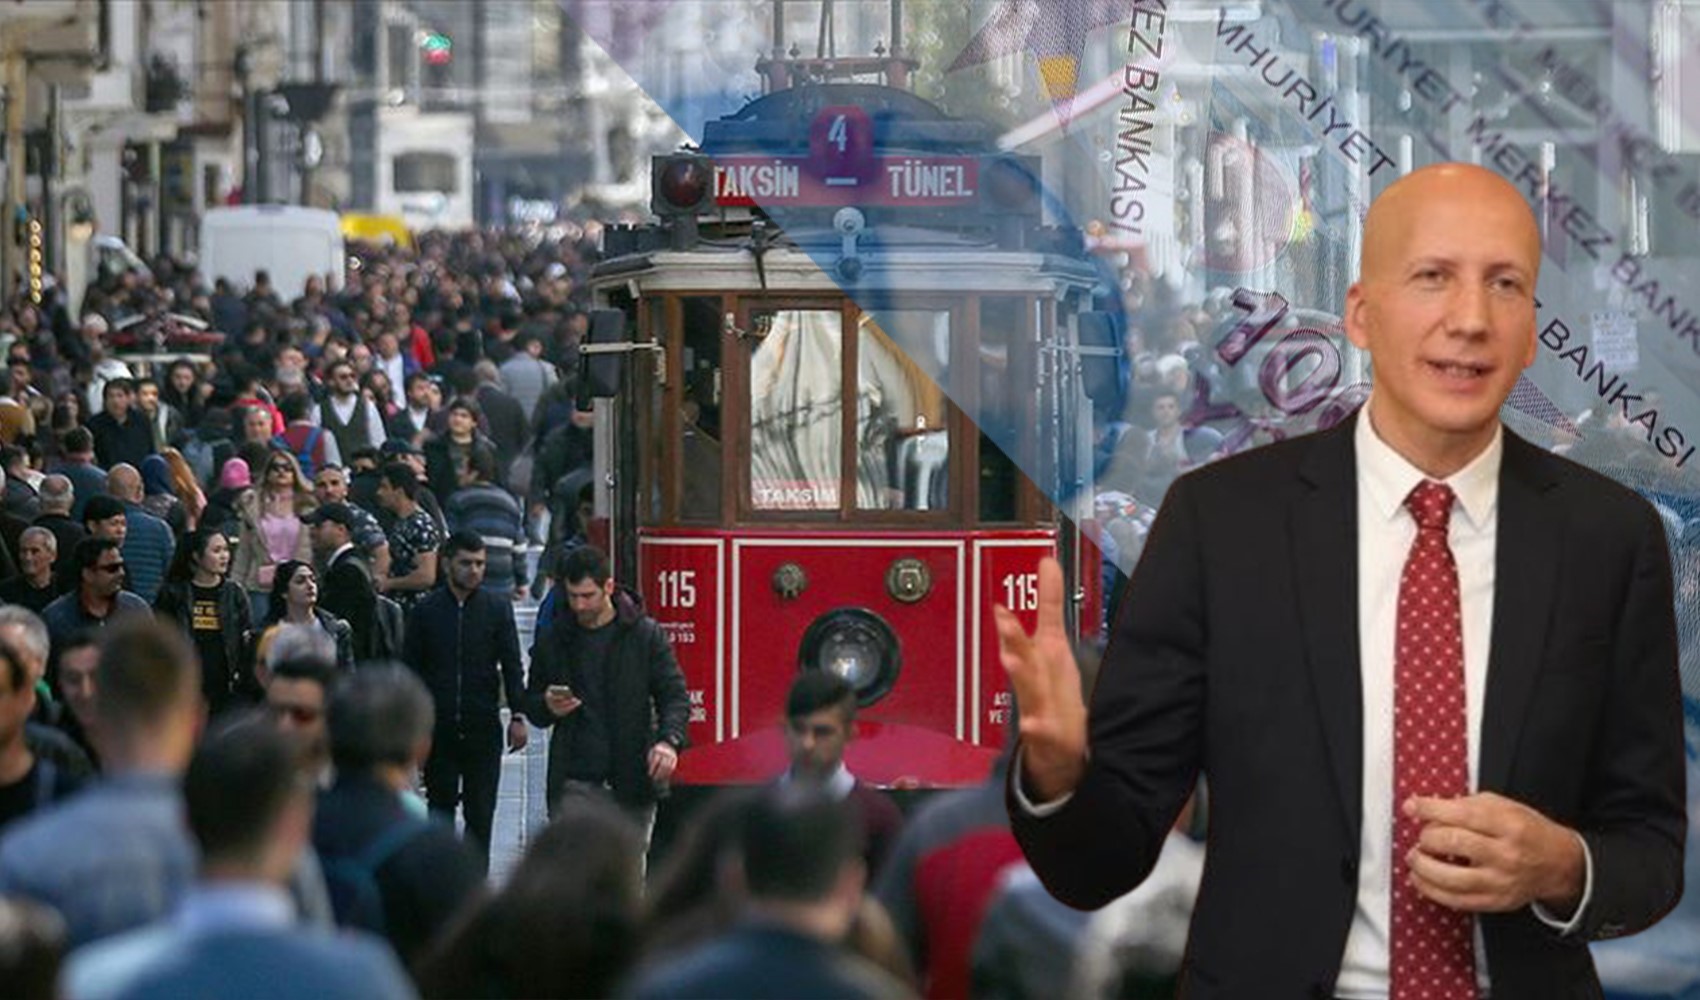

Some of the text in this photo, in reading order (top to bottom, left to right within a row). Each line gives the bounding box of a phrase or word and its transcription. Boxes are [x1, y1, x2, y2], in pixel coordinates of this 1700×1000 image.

[828, 114, 848, 152] 4
[713, 160, 973, 198] TAKSİM TÜNEL
[658, 570, 696, 608] 115
[1003, 573, 1038, 611] 115
